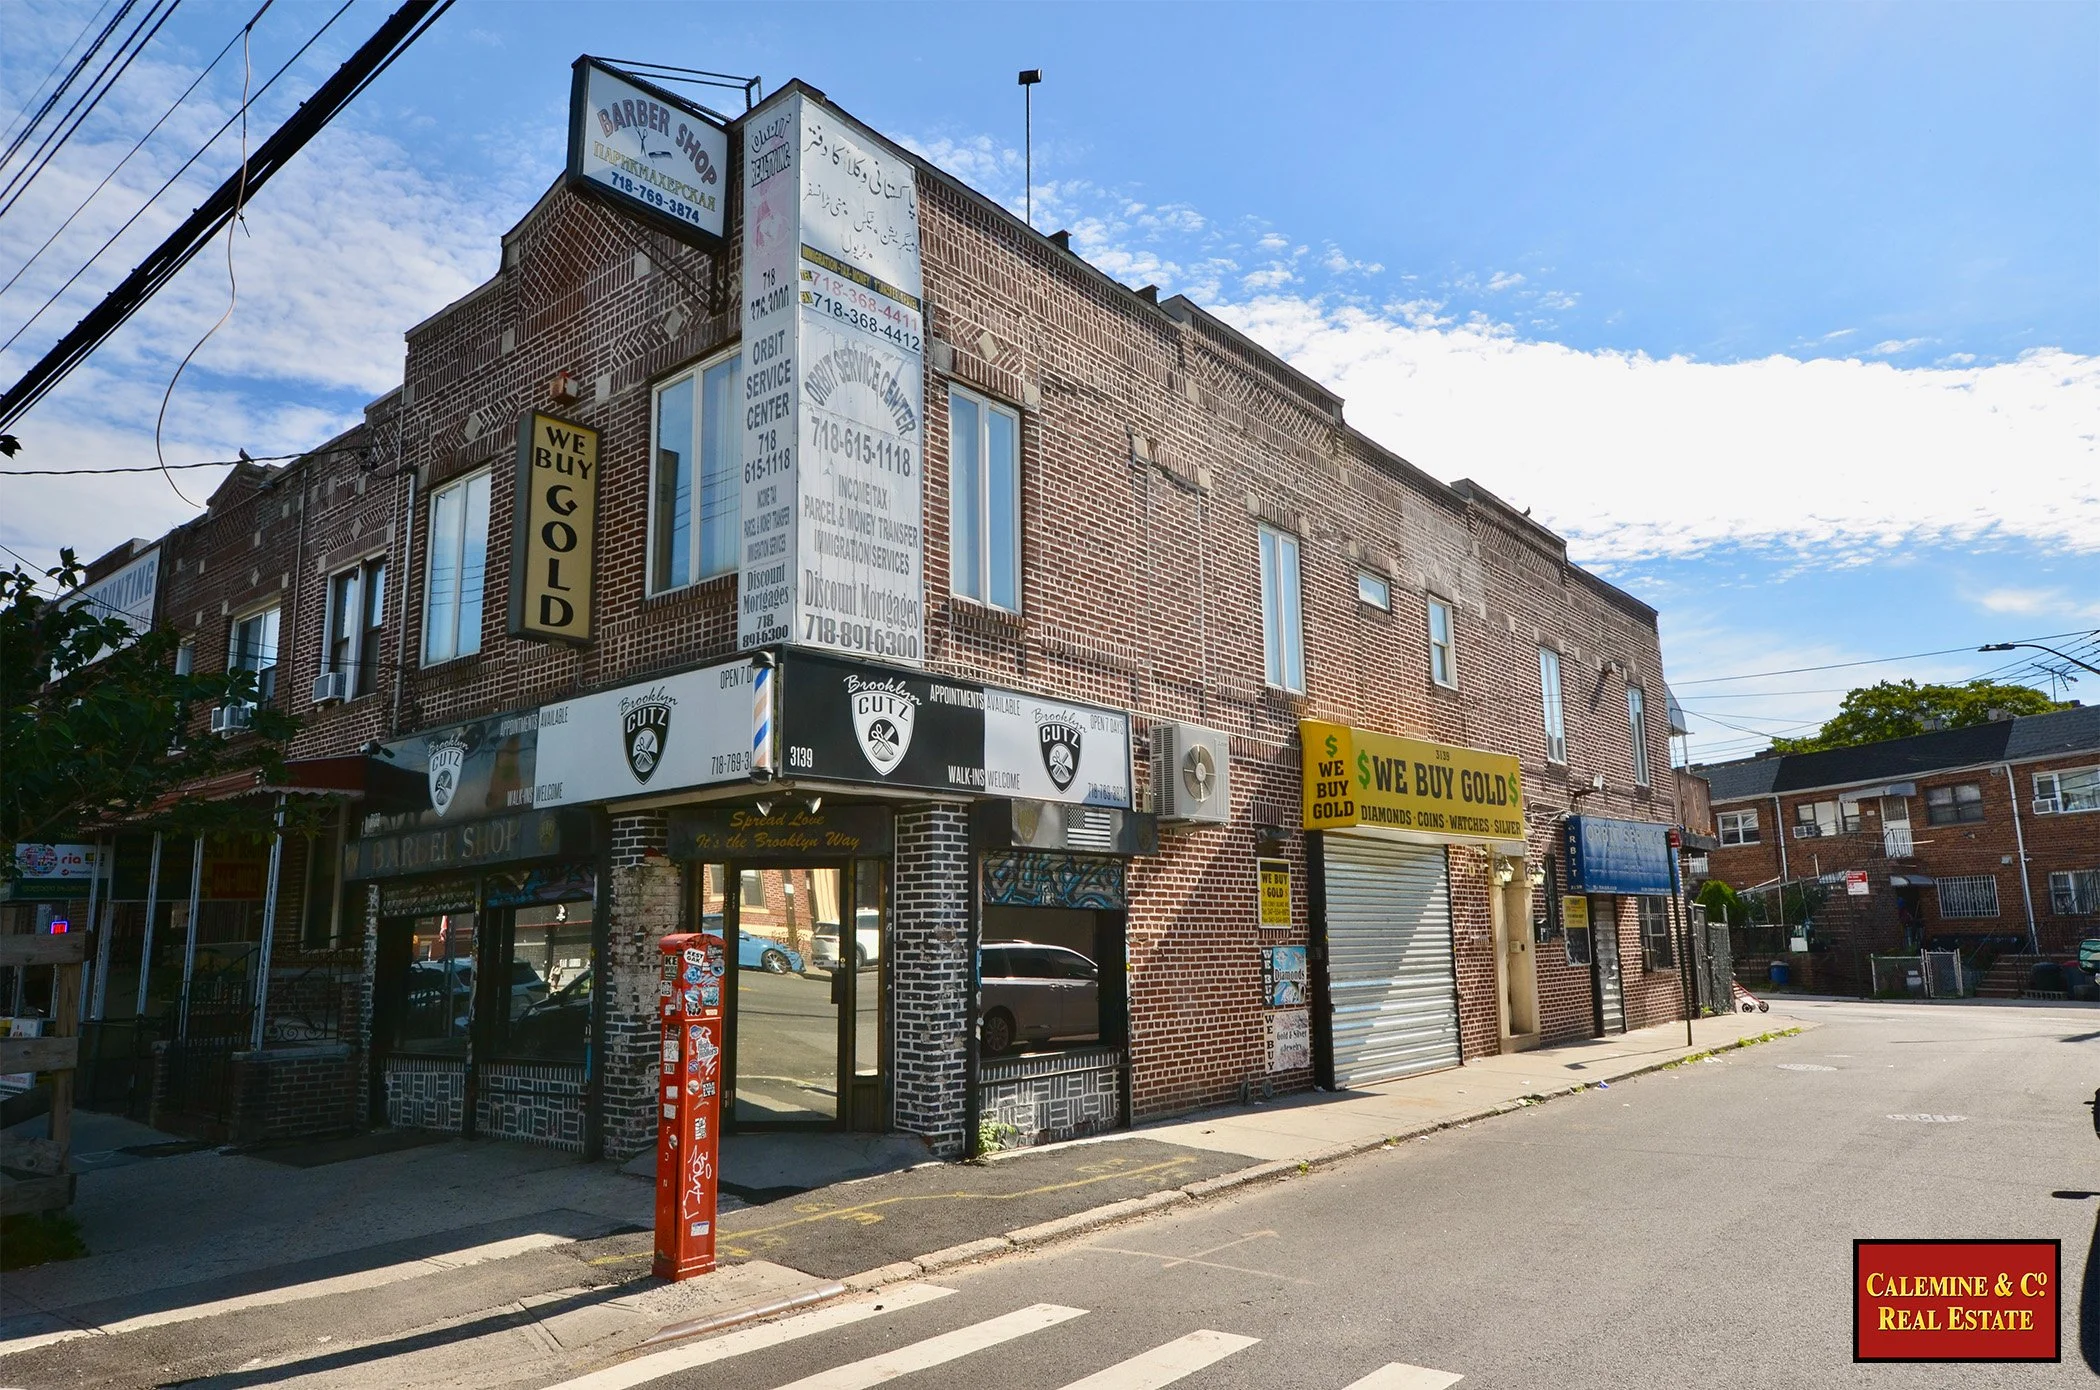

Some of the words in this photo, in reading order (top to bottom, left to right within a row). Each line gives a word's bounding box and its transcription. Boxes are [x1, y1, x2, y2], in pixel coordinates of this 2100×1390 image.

[597, 99, 670, 138] BARBER
[675, 122, 718, 186] SHOP
[593, 140, 716, 212] ПАРИКМАХЕРСКАЯ
[611, 171, 700, 223] 718-769-3874
[763, 267, 775, 291] 718
[812, 270, 918, 331] 718-368-4411
[813, 292, 921, 351] 718-368-4412
[752, 329, 785, 365] ORBIT
[746, 359, 791, 400] SERVICE
[804, 354, 839, 406] ORBIT
[833, 349, 882, 393] SERVICE
[879, 370, 917, 436] CENTER
[746, 392, 790, 430] CENTER
[545, 425, 587, 456] WE
[758, 429, 777, 455] 718
[811, 416, 911, 477] 718-615-1118
[534, 446, 593, 480] BUY
[744, 448, 791, 484] 615-1118
[838, 474, 871, 506] INCOME
[872, 485, 888, 510] TAX
[804, 495, 836, 526] PARCEL
[838, 506, 845, 527] &
[847, 508, 876, 537] MONEY
[878, 515, 918, 549] TRANSFER
[540, 484, 579, 627] GOLD
[814, 528, 869, 566] IMMIGRATION
[871, 544, 910, 576] SERVICES
[747, 562, 786, 592] Discount
[743, 585, 789, 616] Mortgages
[805, 569, 857, 616] Discount
[861, 583, 918, 631] Mortgages
[756, 613, 775, 631] 718
[805, 613, 918, 659] 718-891-6300
[720, 669, 739, 690] OPEN
[740, 666, 746, 685] 7
[843, 674, 923, 706] Brooklyn
[618, 686, 678, 715] Brooklyn
[858, 696, 910, 722] CUTZ
[930, 684, 985, 710] APPOINTMENTS
[986, 694, 1021, 717] AVAILABLE
[500, 712, 539, 737] APPOINTMENTS
[540, 706, 569, 728] AVAILABLE
[627, 707, 667, 733] CUTZ
[1031, 707, 1088, 734] Brooklyn
[427, 738, 470, 757] Brooklyn
[1042, 725, 1080, 749] CUTZ
[431, 750, 461, 772] CUTZ
[790, 746, 813, 768] 3139
[1436, 750, 1450, 761] 3139
[948, 765, 985, 787] WALK-INS
[988, 770, 1021, 791] WELCOME
[1318, 760, 1344, 778] WE
[1373, 755, 1409, 795] WE
[1414, 762, 1454, 800] BUY
[1461, 769, 1507, 807] GOLD
[507, 787, 534, 807] WALK-INS
[536, 782, 564, 802] WELCOME
[1316, 780, 1349, 799] BUY
[730, 810, 786, 831] Spread
[788, 811, 825, 827] Love
[1313, 801, 1354, 819] GOLD
[1361, 805, 1412, 826] DIAMONDS
[1417, 812, 1445, 829] COINS
[1449, 814, 1490, 833] WATCHES
[1494, 819, 1522, 836] SILVER
[461, 819, 520, 858] SHOP
[696, 834, 720, 849] It's
[724, 832, 748, 849] the
[753, 831, 819, 851] Brooklyn
[825, 831, 861, 850] Way
[1586, 824, 1620, 843] ORBIT
[62, 853, 81, 863] ria
[1261, 873, 1272, 884] WE
[1274, 874, 1288, 885] BUY
[1267, 887, 1284, 898] GOLD
[1274, 968, 1305, 982] Diamonds
[1264, 1015, 1275, 1034] WE
[1277, 1031, 1288, 1041] Gold
[1293, 1028, 1307, 1039] Silver
[1266, 1041, 1275, 1071] BUY
